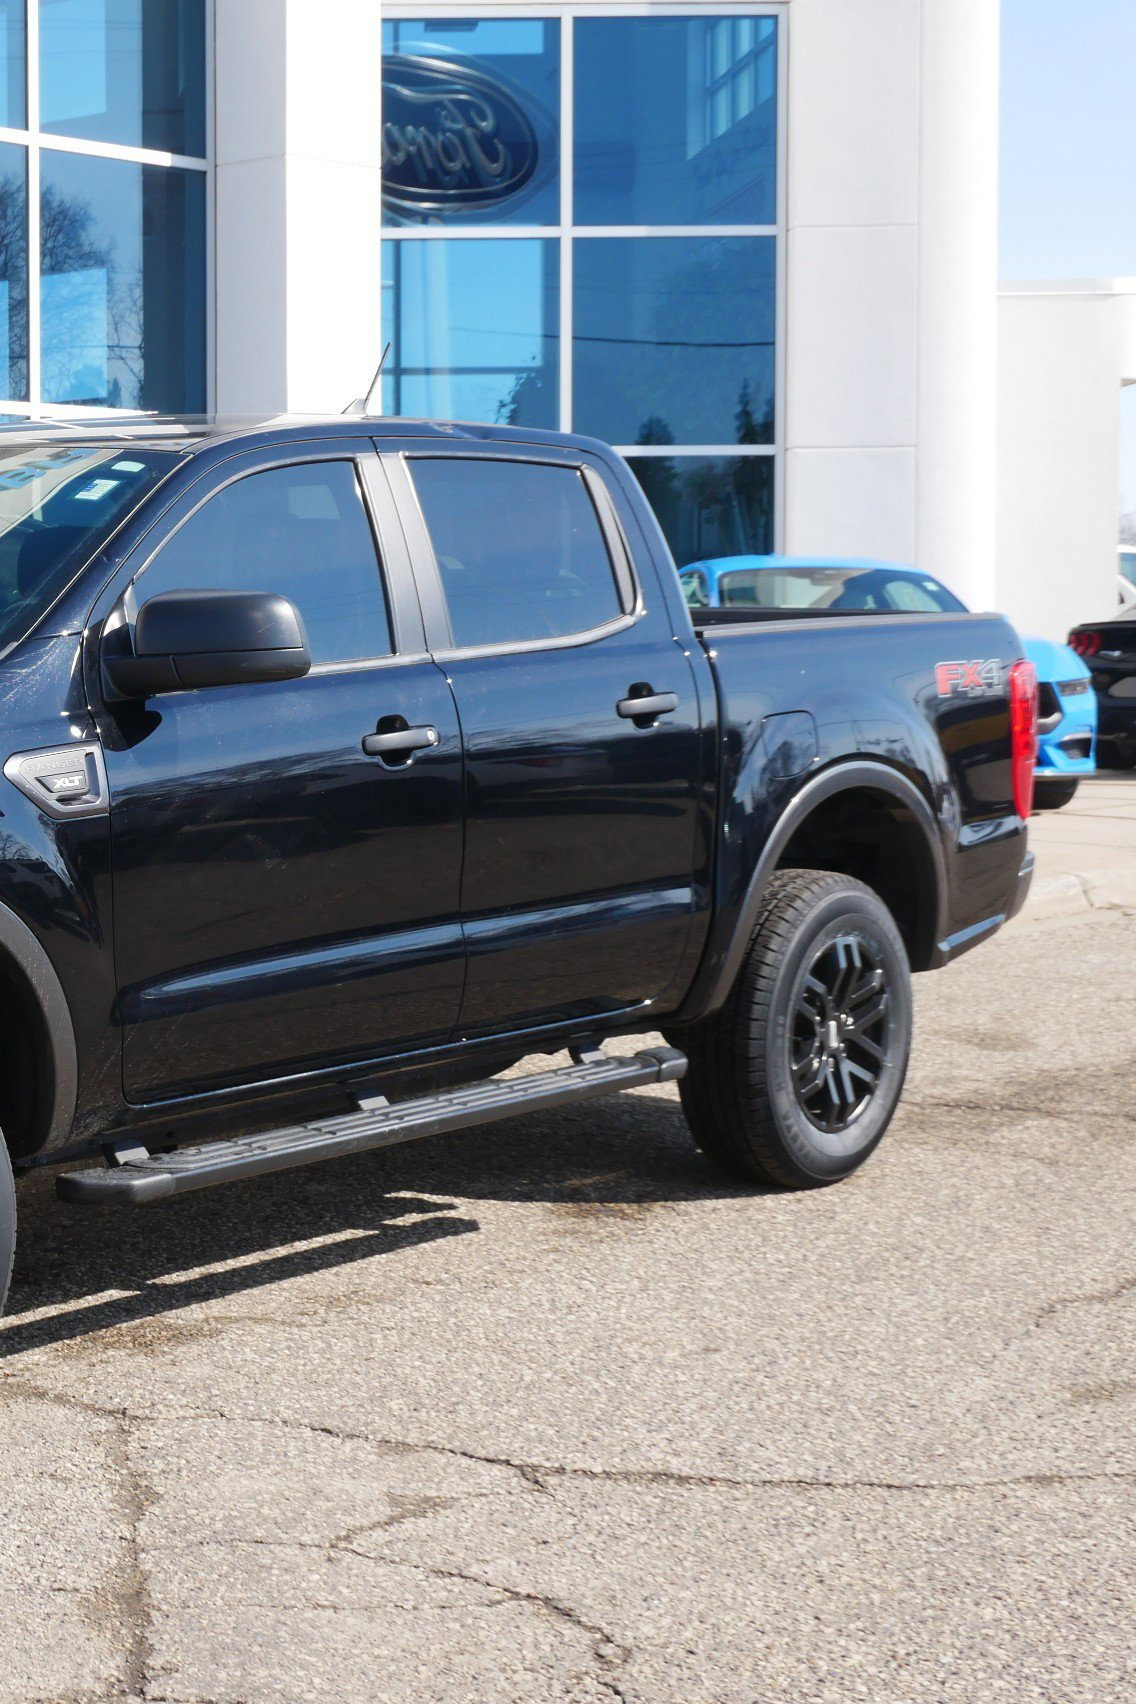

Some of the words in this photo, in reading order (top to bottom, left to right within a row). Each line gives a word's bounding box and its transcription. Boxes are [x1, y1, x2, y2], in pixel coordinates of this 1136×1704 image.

[934, 658, 1004, 697] FX4
[25, 757, 84, 773] RANGER
[52, 775, 83, 789] XLT
